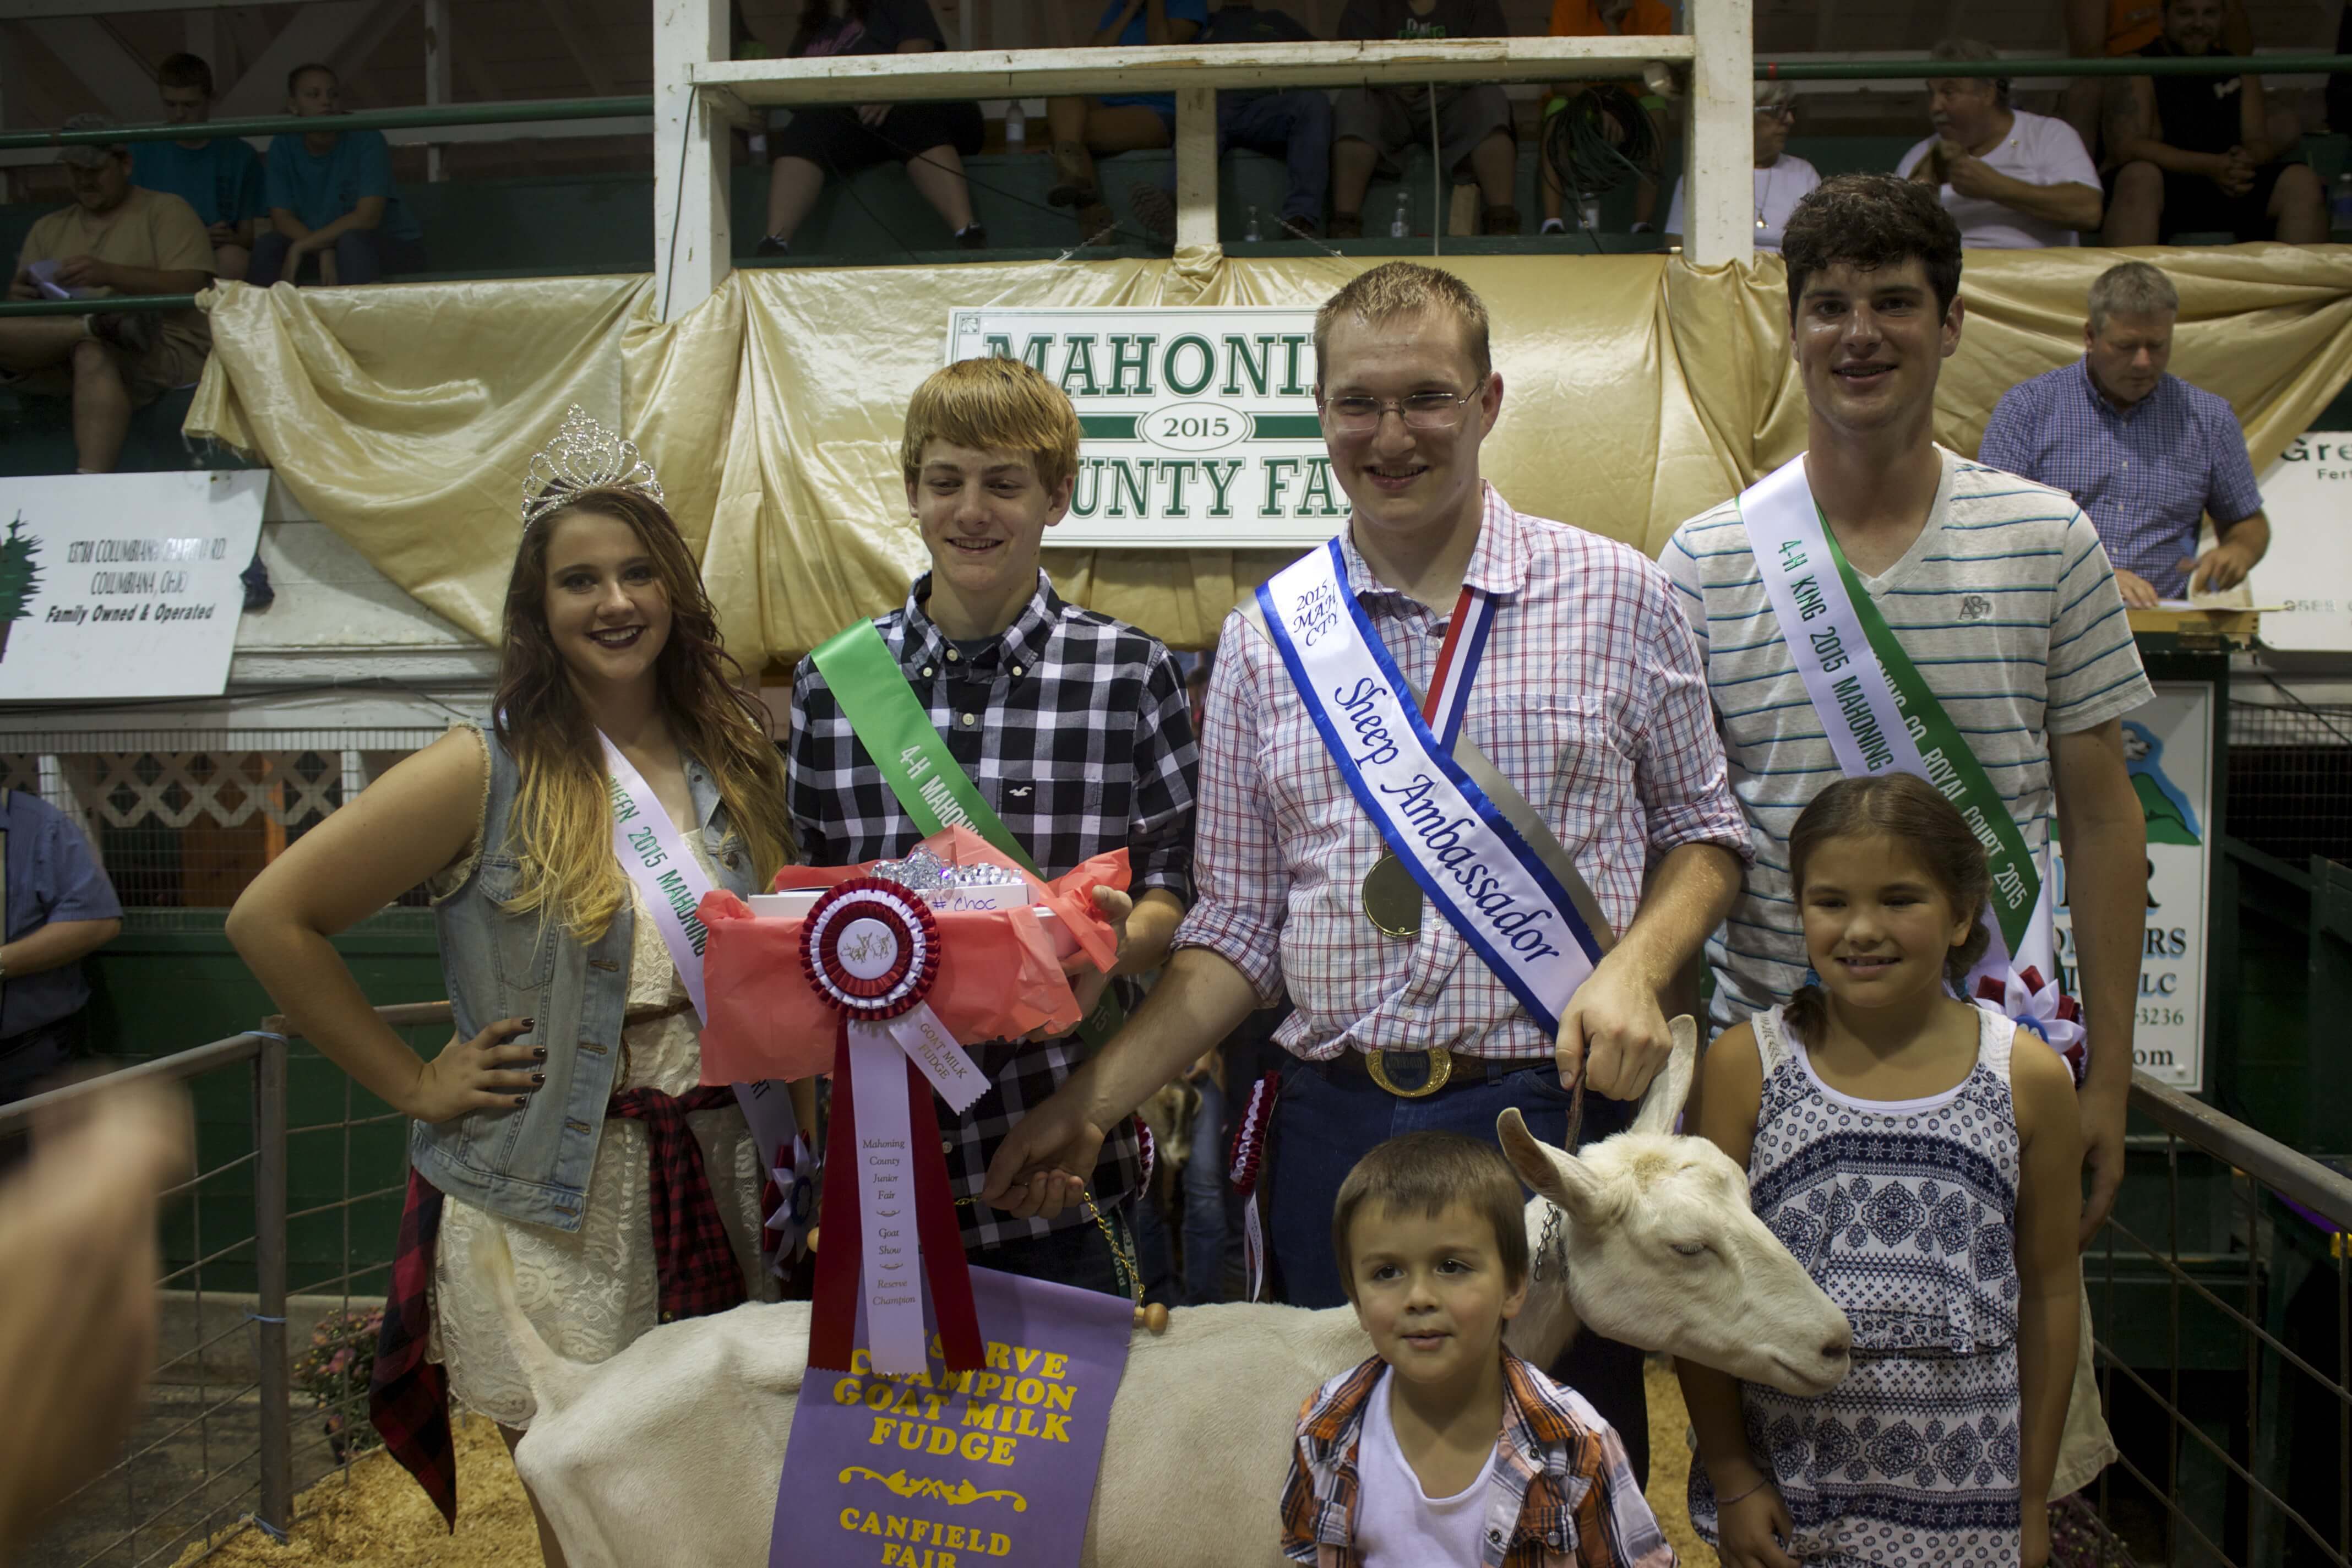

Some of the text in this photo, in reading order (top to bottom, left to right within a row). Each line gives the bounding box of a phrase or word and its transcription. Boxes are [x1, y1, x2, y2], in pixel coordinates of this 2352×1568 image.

[983, 333, 1317, 398] MAHONI
[1162, 417, 1229, 437] 2015
[1070, 456, 1245, 519] UNTY
[1778, 539, 1809, 572] 4-H
[1293, 583, 1336, 633] MAH
[1296, 578, 1327, 612] 2015
[1790, 574, 1827, 622] KING
[46, 603, 216, 625] Family Owned & Operated
[1810, 625, 1850, 673] 2015
[1832, 675, 1894, 772] MAHONING
[900, 745, 931, 780] 4-H
[1335, 677, 1560, 963] Sheep Ambassador
[628, 826, 668, 868] 2015
[1993, 862, 2028, 910] 2015
[919, 1044, 950, 1080] FUDGE
[920, 1023, 967, 1079] GOAT MILK
[863, 1139, 905, 1150] Mahoning
[869, 1156, 900, 1167] County
[873, 1173, 899, 1184] Junior
[878, 1190, 896, 1200] Fair
[879, 1228, 899, 1238] Goat
[879, 1246, 901, 1255] Show
[872, 1295, 916, 1306] Champion
[877, 1280, 908, 1289] Reserve
[851, 1348, 1077, 1411] CAMPION
[833, 1378, 1072, 1442] GOAT MILK
[869, 1416, 1017, 1466] FUDGE
[840, 1507, 1011, 1556] CANFIELD
[881, 1542, 957, 1568] FAIR
